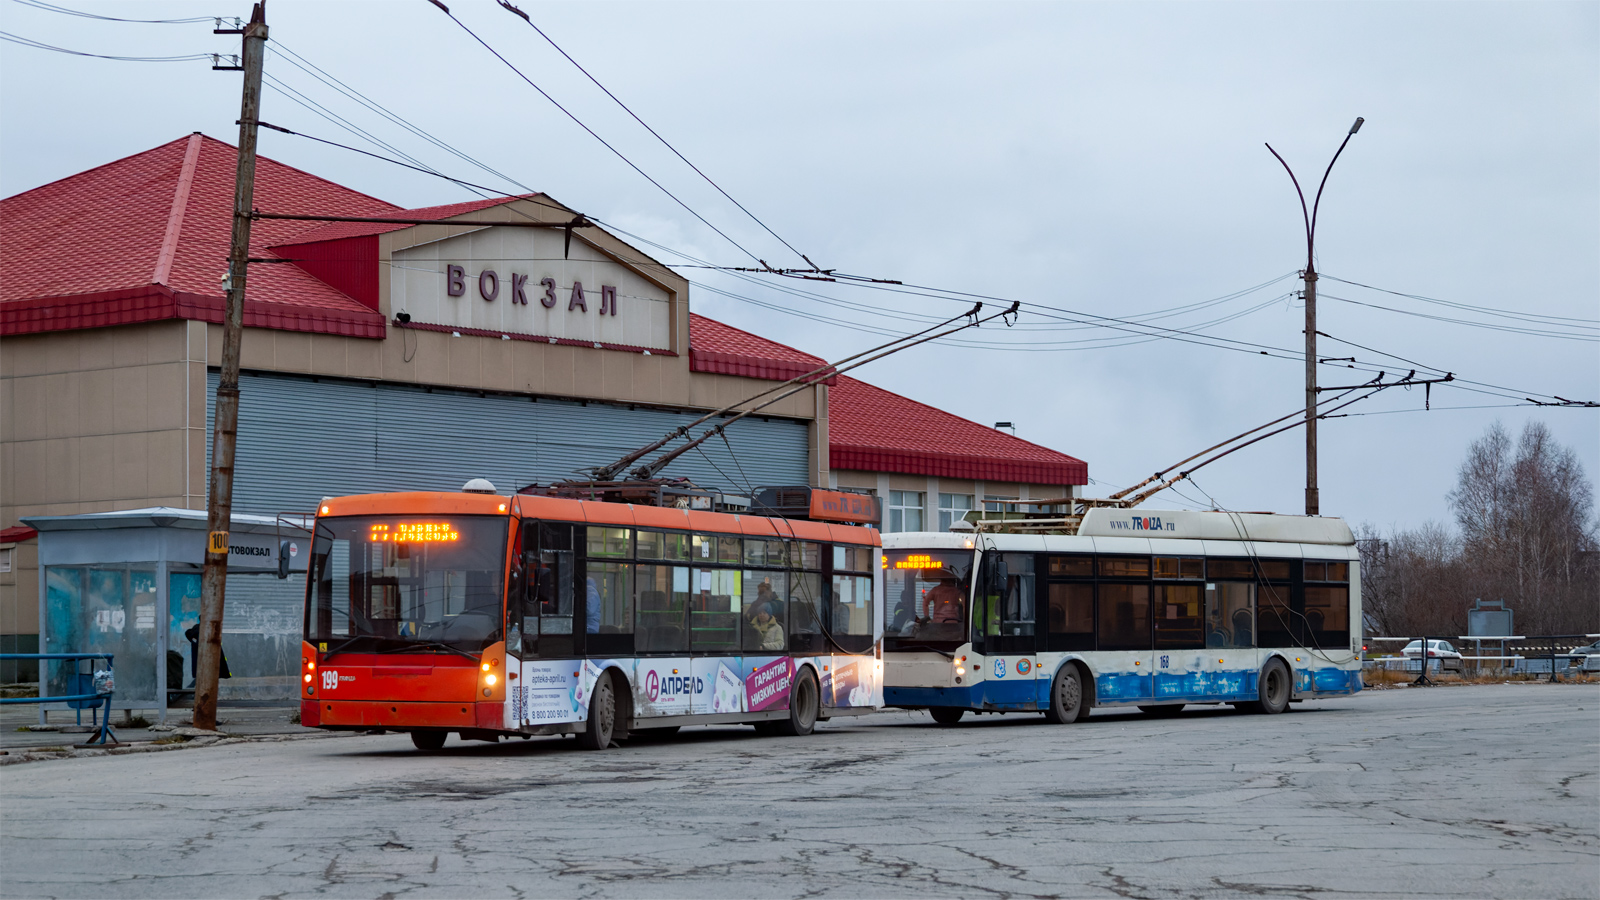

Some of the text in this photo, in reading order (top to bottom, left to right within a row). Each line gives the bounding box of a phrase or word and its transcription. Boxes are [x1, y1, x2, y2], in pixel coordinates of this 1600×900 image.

[447, 264, 617, 316] ВОКЗАЛ
[1160, 655, 1169, 669] 168
[321, 670, 338, 690] 199
[532, 674, 566, 685] apteka-april.ru
[754, 661, 787, 688] ГАРАНТИЯ
[660, 676, 703, 695] АПРЕЛЬ
[751, 675, 790, 707] НИЗКИХ ЦЕН
[532, 711, 536, 719] 8
[536, 711, 546, 719] 800
[547, 710, 556, 719] 200
[556, 710, 563, 718] 90
